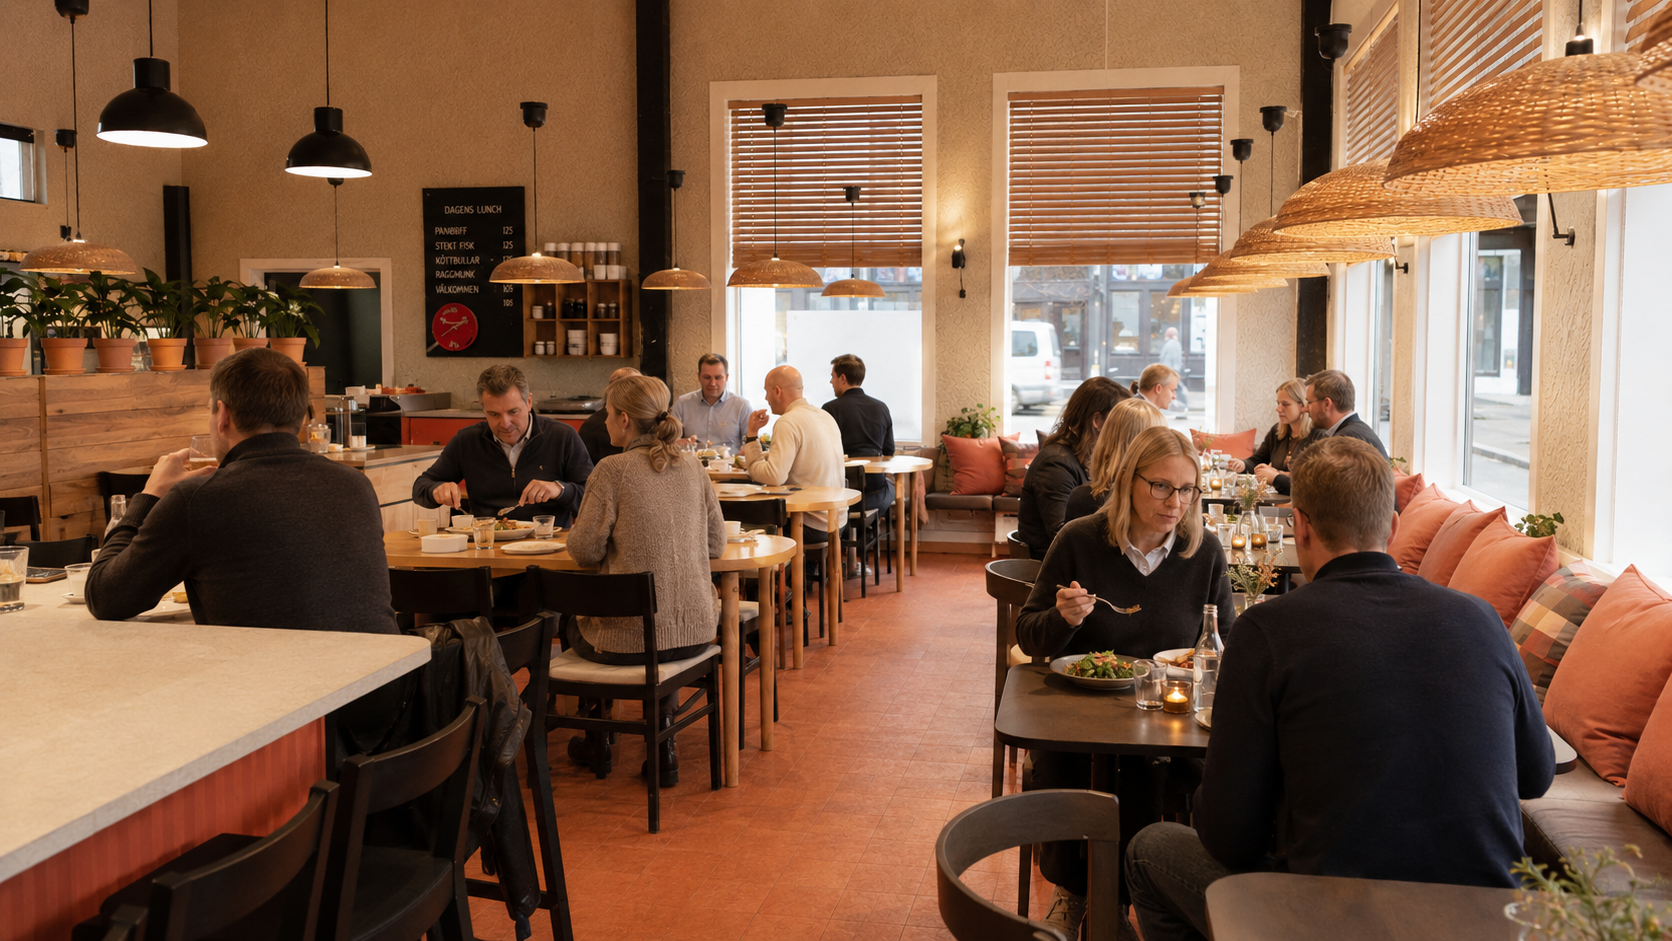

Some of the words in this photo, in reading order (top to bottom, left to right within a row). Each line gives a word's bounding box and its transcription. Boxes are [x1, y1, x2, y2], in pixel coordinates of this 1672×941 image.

[445, 205, 474, 214] DAGENS
[476, 205, 502, 214] LUNCH
[502, 226, 513, 235] 125
[459, 241, 475, 250] FISK
